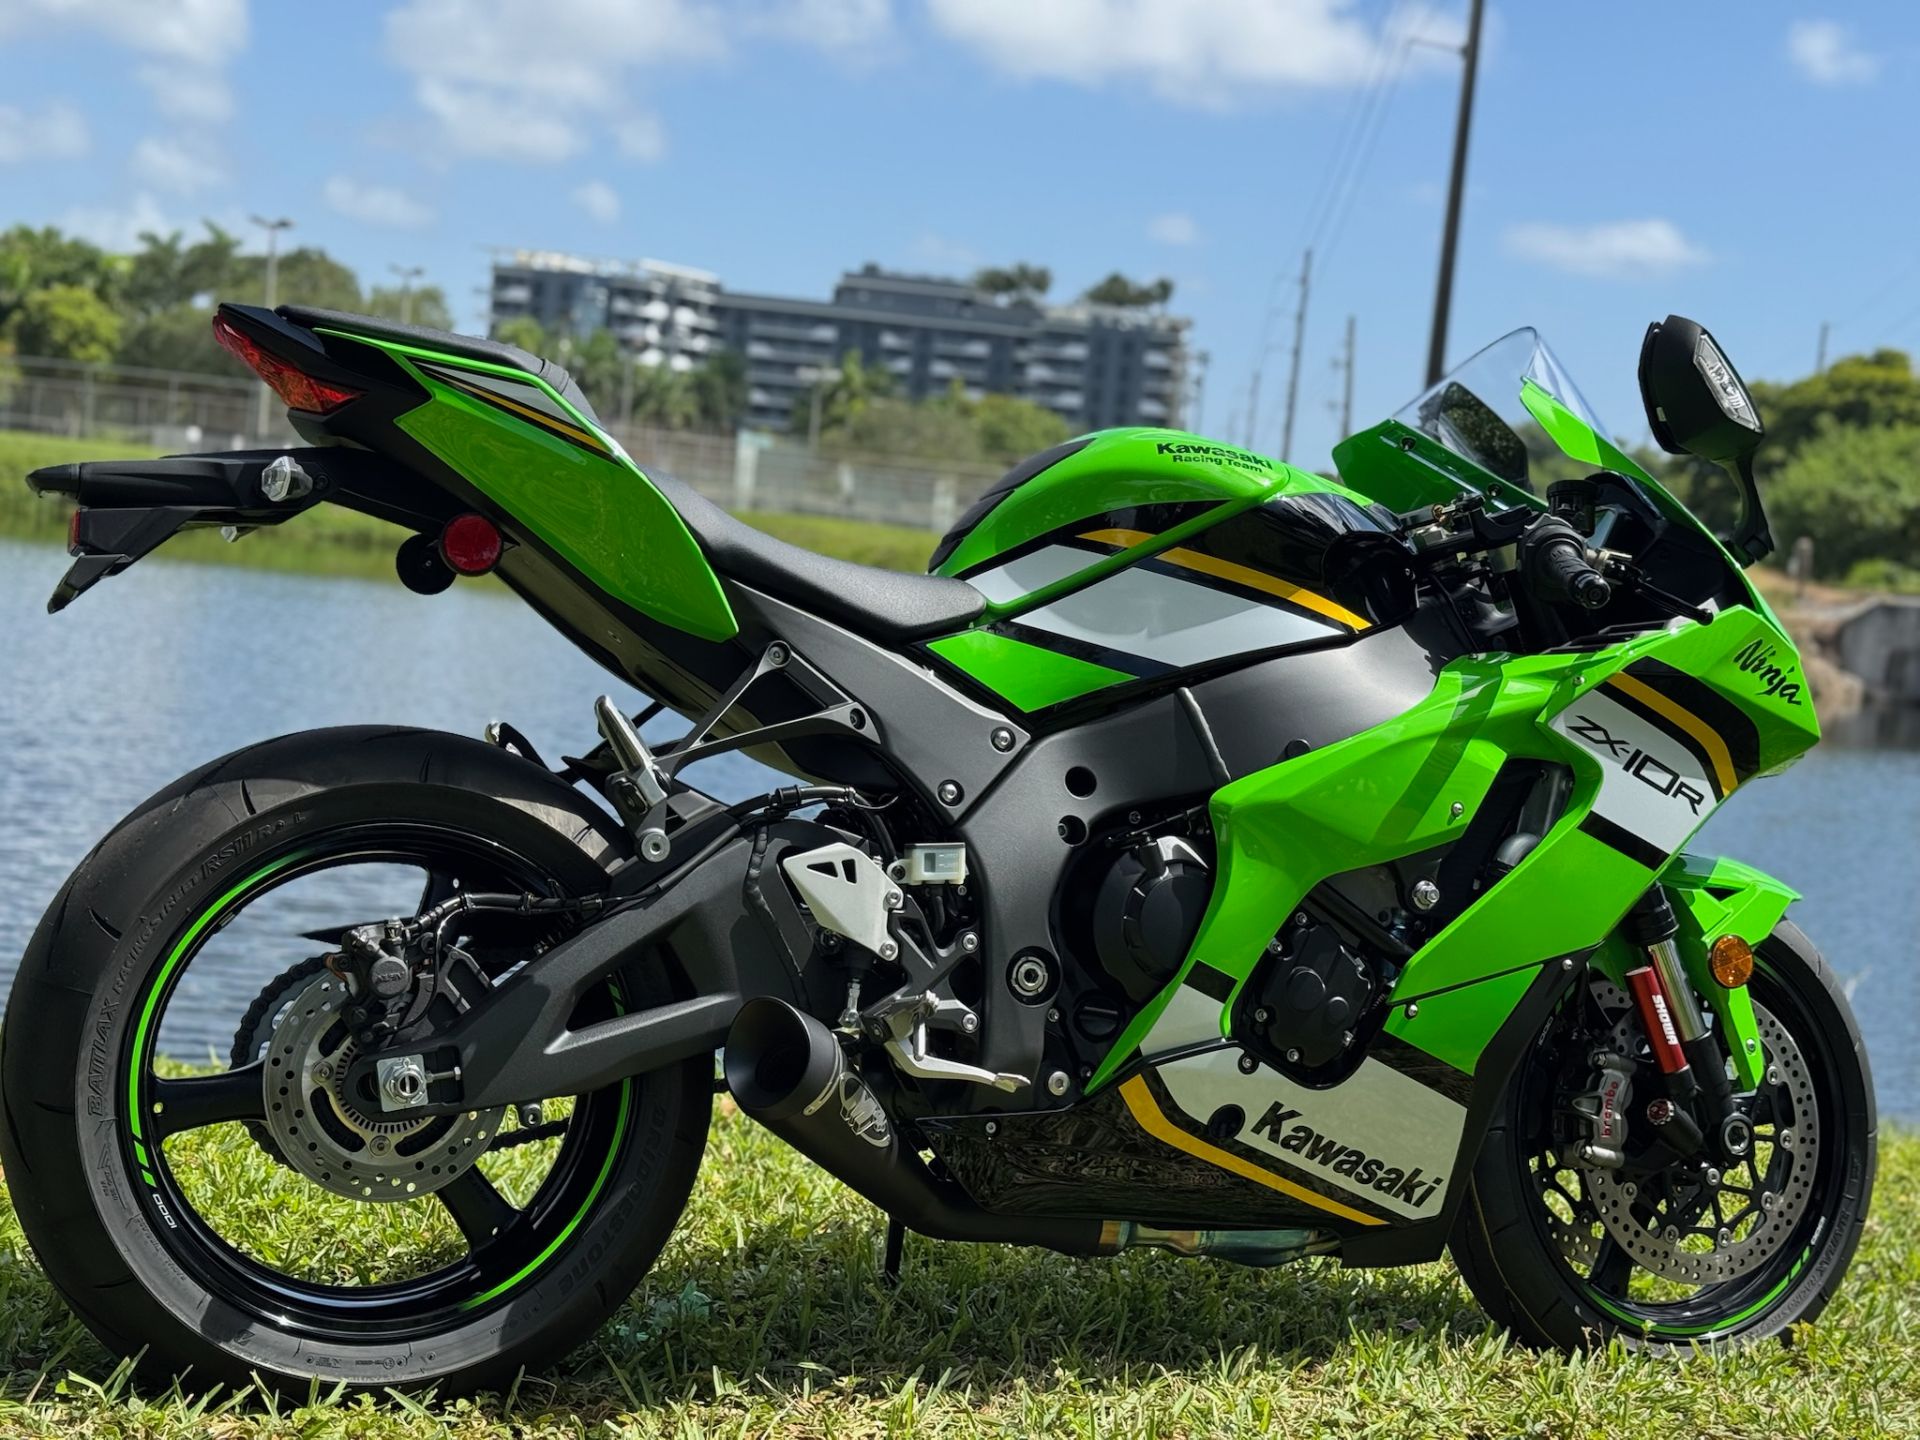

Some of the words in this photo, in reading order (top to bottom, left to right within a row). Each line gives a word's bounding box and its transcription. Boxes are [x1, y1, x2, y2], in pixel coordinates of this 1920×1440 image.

[1156, 442, 1273, 470] Kawasaki
[1172, 454, 1223, 466] Racing
[1225, 457, 1263, 473] Team
[1732, 638, 1802, 706] Ninja
[1566, 715, 1705, 817] ZX-10R
[1651, 994, 1679, 1046] SHOWA
[1601, 1081, 1619, 1138] brembo
[1250, 1100, 1445, 1209] Kawasaki
